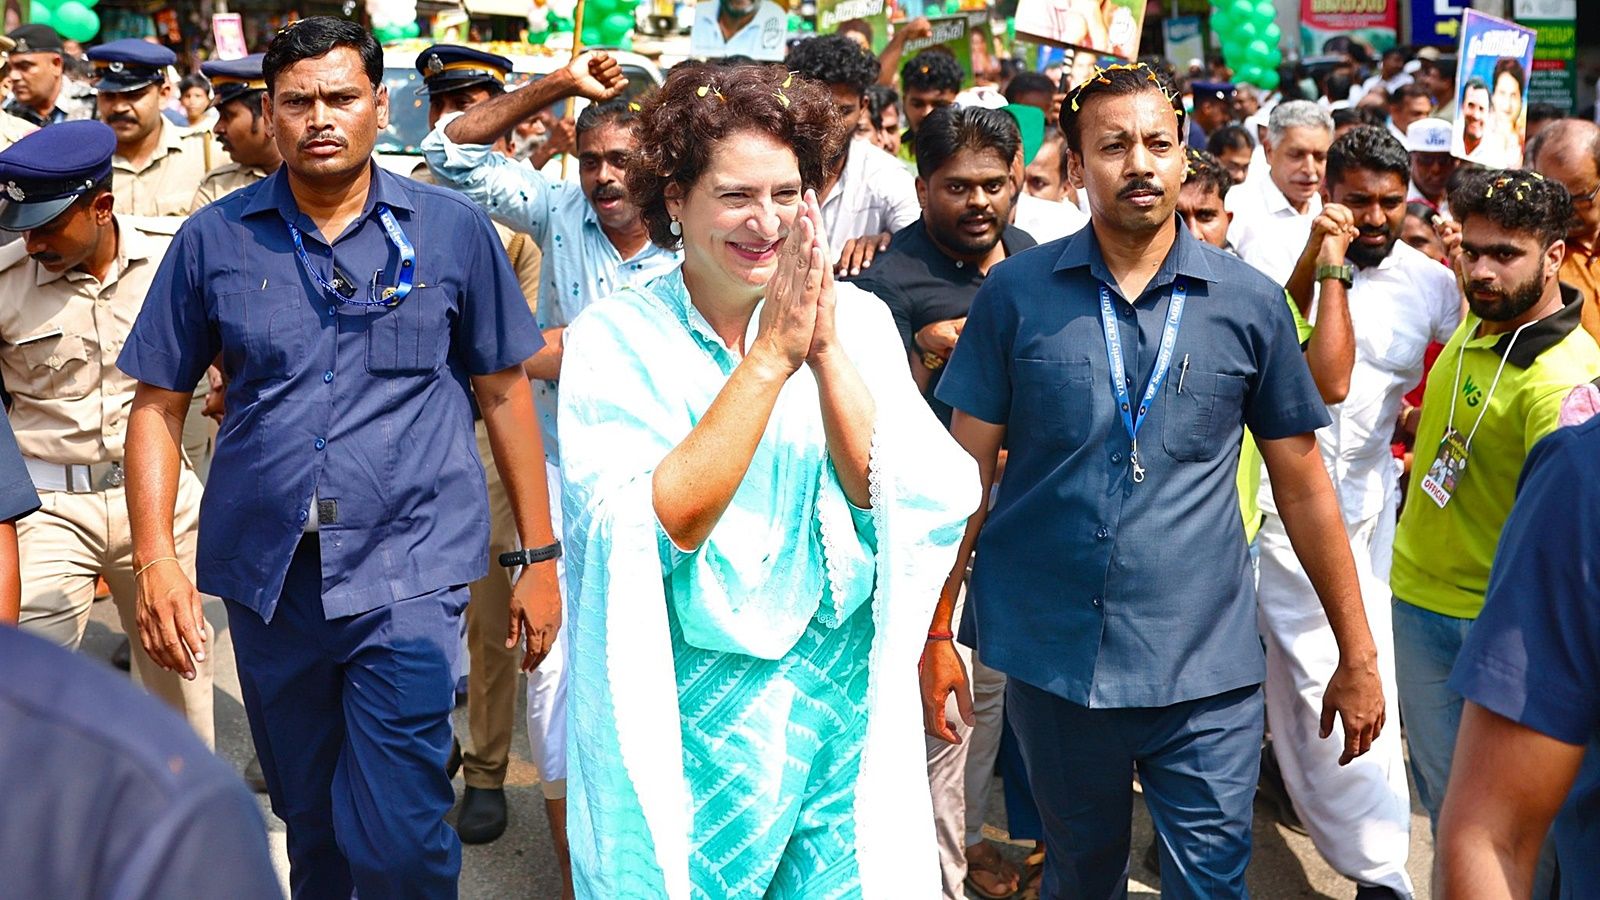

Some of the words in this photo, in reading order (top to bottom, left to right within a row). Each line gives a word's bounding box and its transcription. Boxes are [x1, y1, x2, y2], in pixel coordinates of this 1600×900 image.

[1111, 341, 1121, 379] Security
[1145, 383, 1156, 400] VIP
[1152, 349, 1171, 385] Security
[1116, 379, 1125, 397] VIP
[1423, 479, 1448, 505] OFFICIAL
